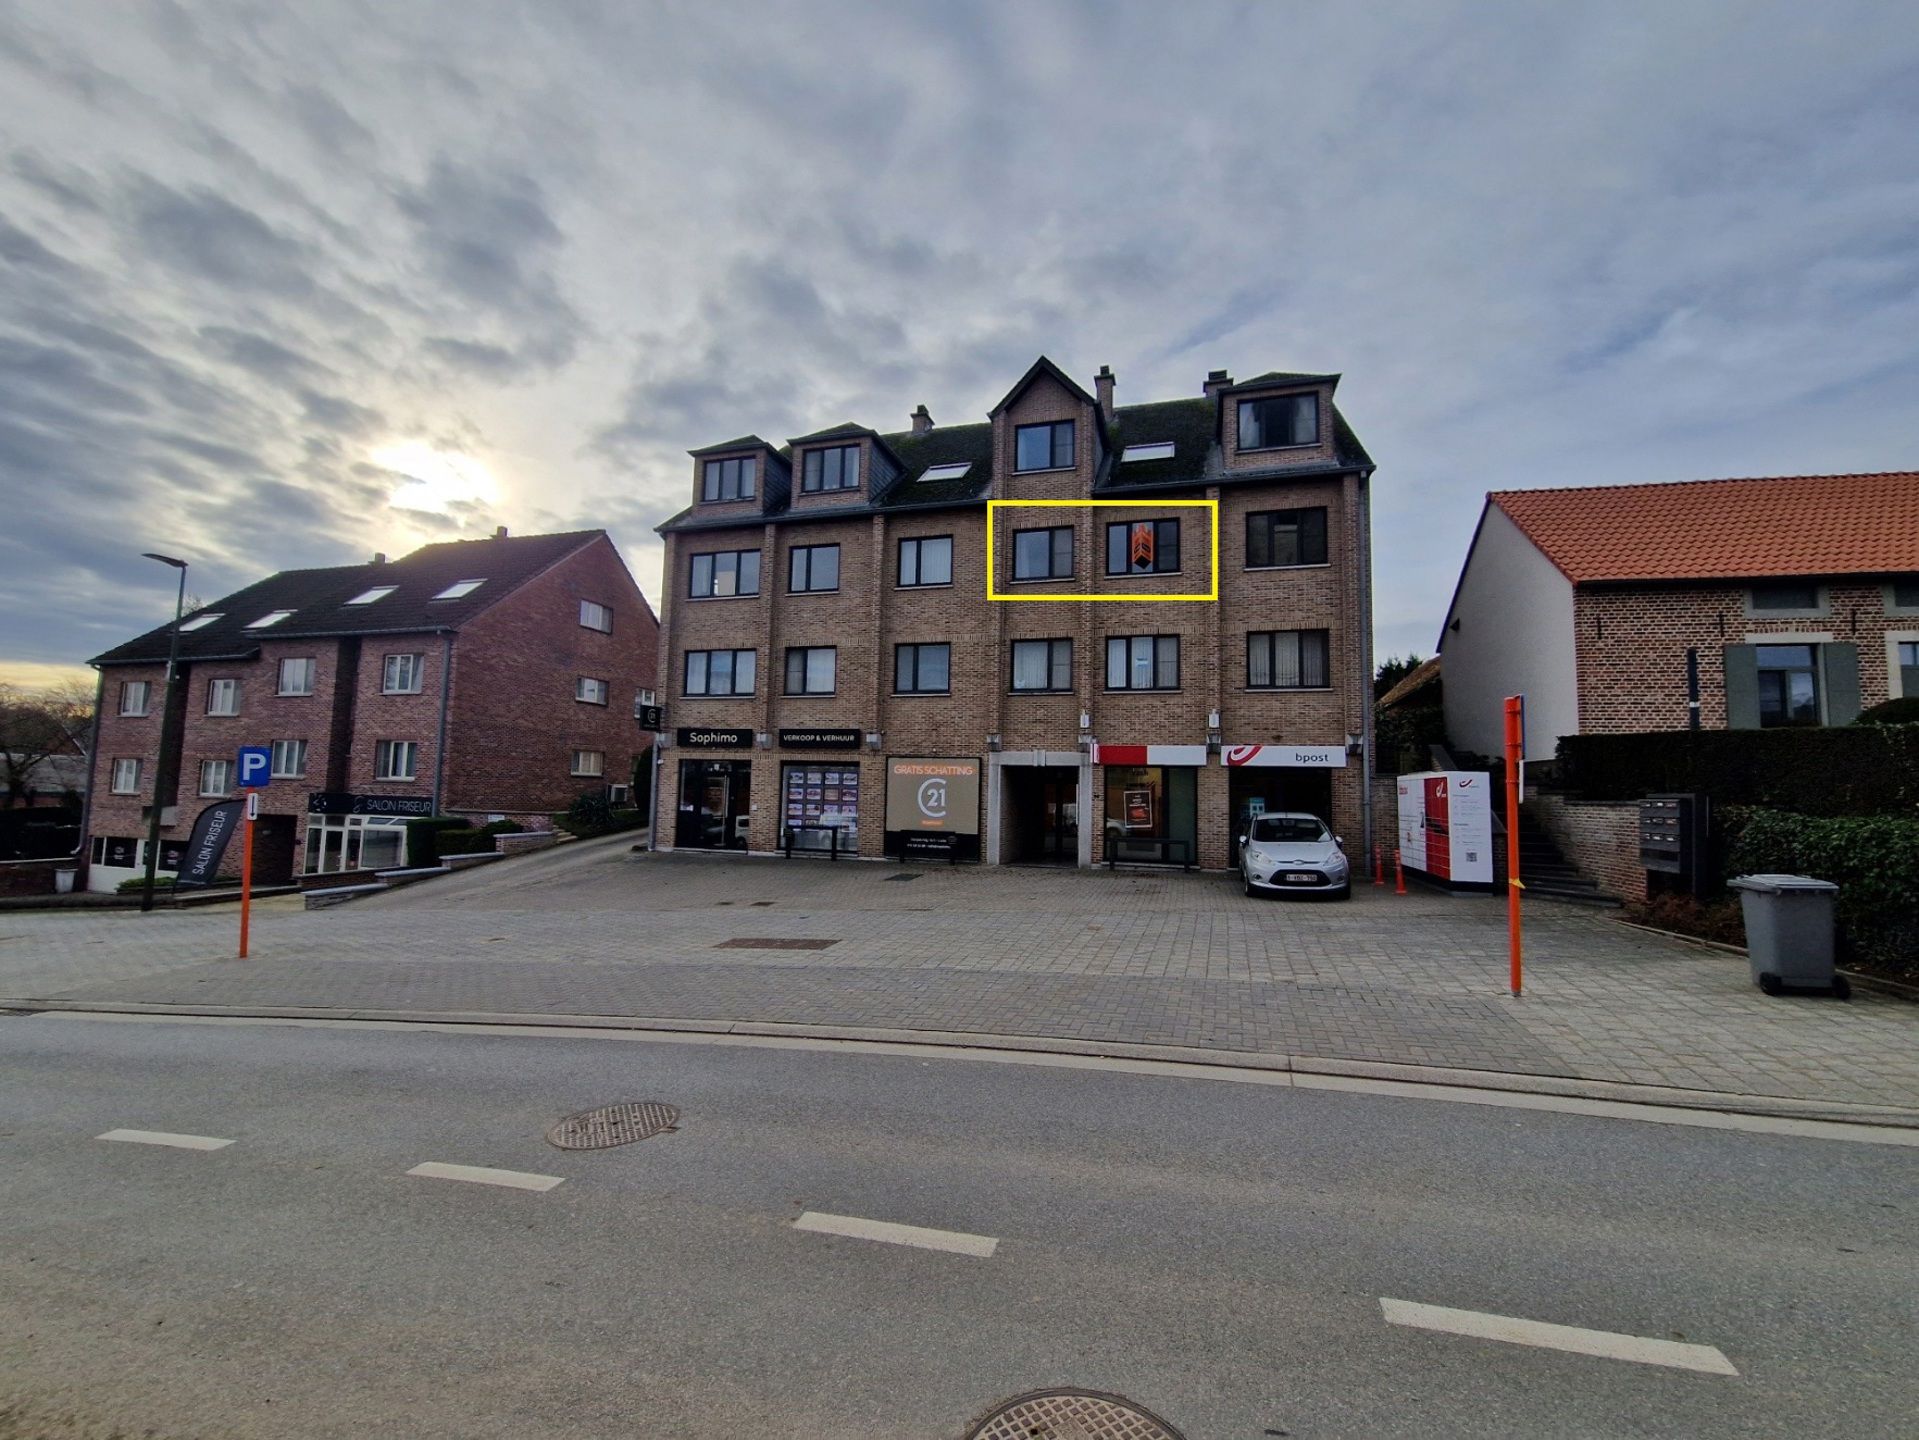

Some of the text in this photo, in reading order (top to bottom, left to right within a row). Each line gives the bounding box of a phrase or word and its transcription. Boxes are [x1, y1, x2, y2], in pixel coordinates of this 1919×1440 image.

[689, 732, 738, 745] Sophimo
[783, 734, 815, 742] VERKOOP
[1295, 752, 1328, 764] bpost
[243, 753, 267, 781] P
[894, 765, 973, 775] GRATIS SCHATTING
[366, 799, 432, 812] SALON FRISEUR
[192, 810, 228, 875] SALON FRISEUR
